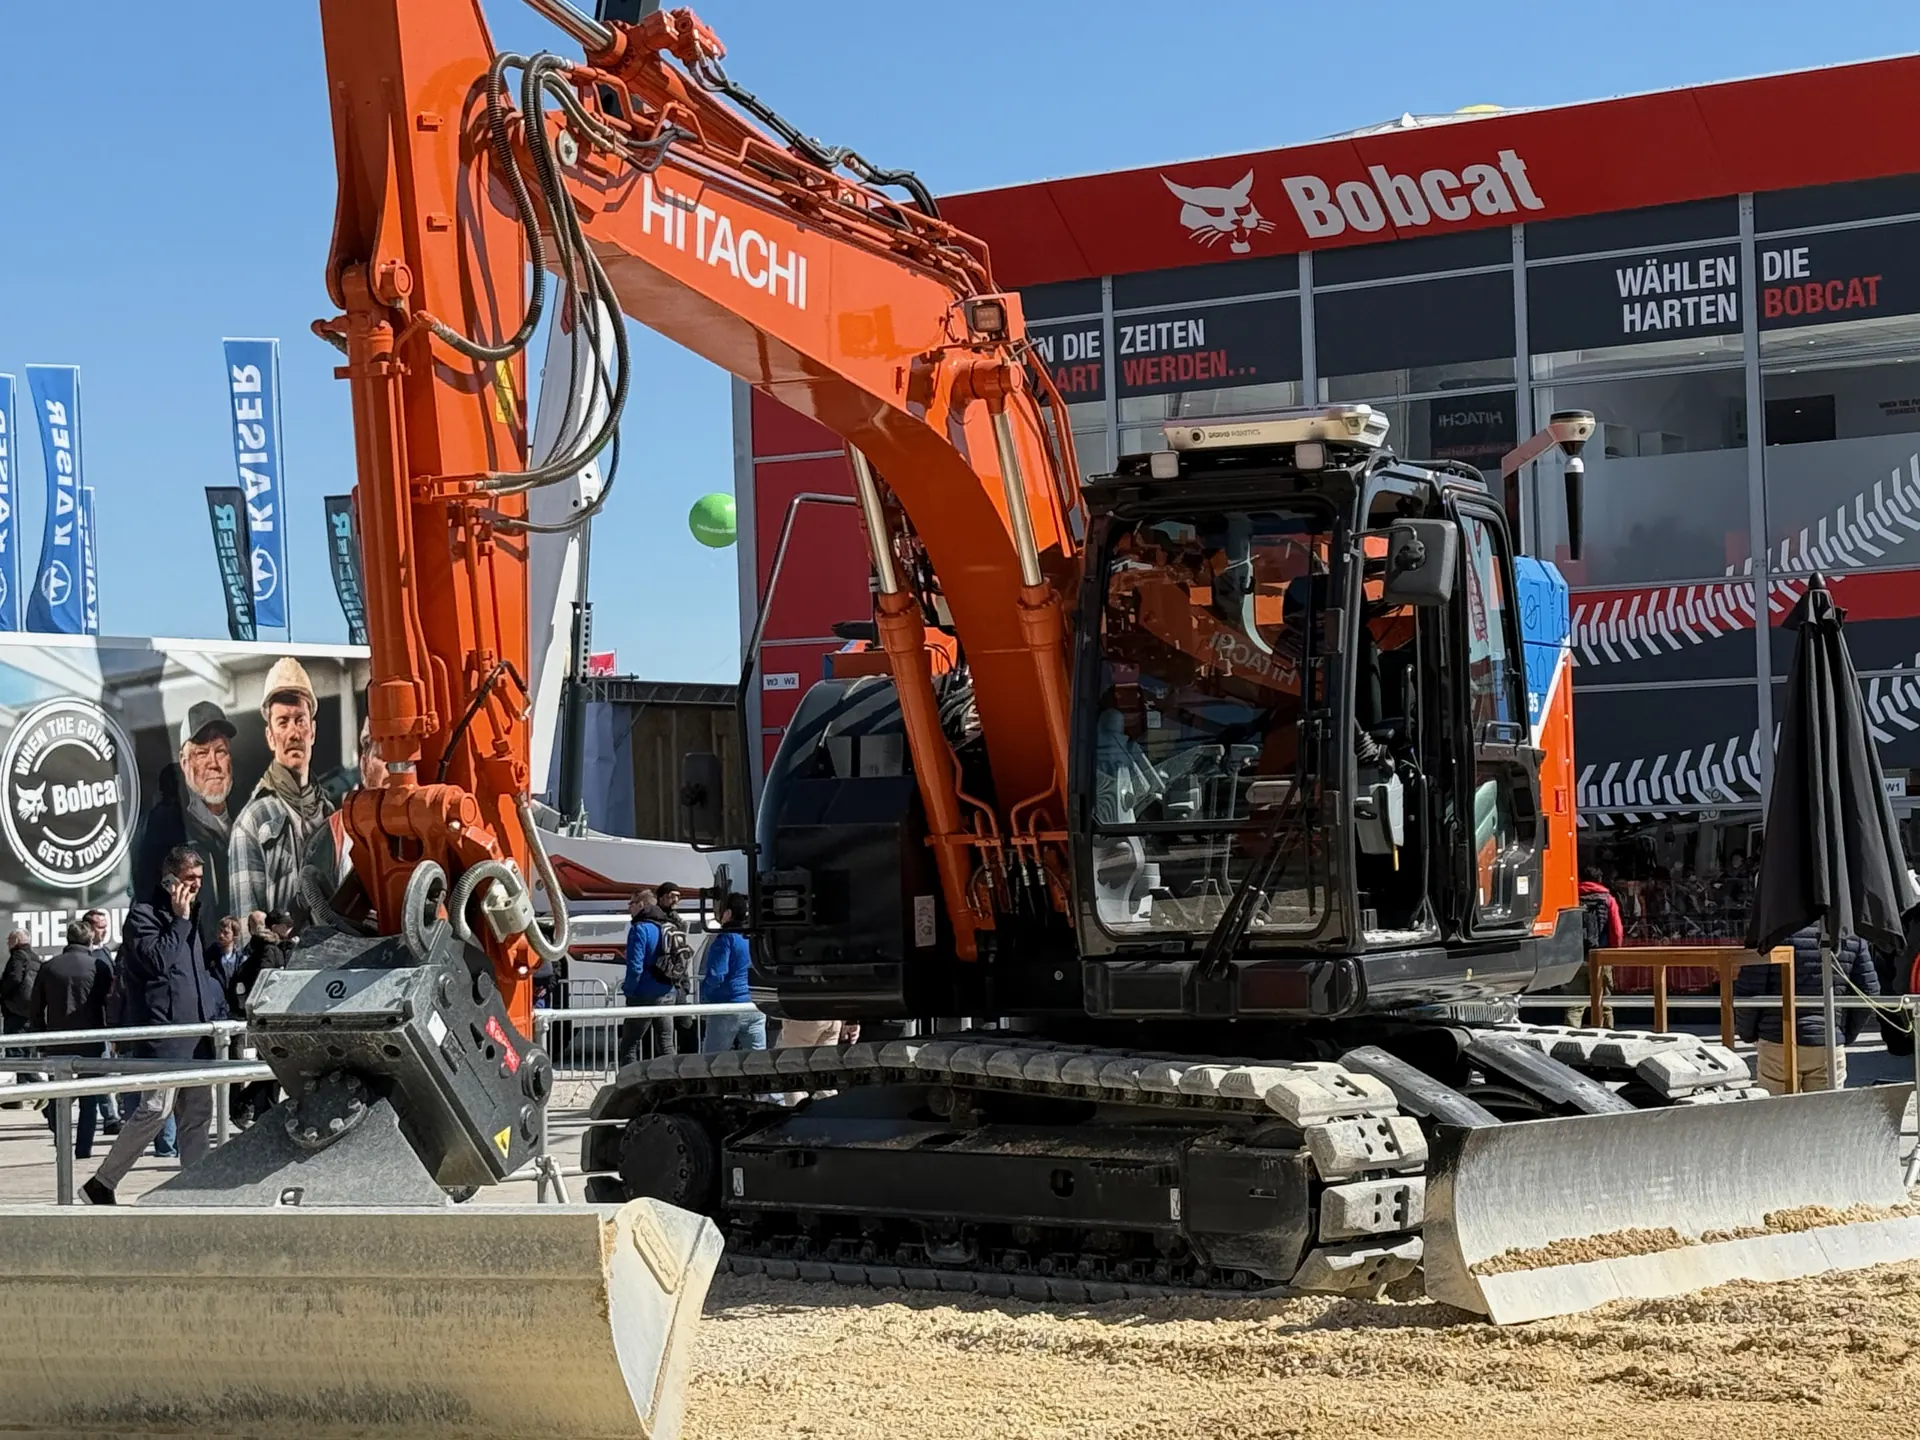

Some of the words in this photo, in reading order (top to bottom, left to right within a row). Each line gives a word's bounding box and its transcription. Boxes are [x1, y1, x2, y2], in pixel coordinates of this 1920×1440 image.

[1281, 149, 1545, 239] Bobcat
[642, 175, 807, 311] HITACHI
[1616, 255, 1736, 297] WÄHLEN
[1762, 247, 1810, 281] DIE
[1623, 292, 1737, 333] HARTEN
[1764, 274, 1882, 318] BOBCAT
[1063, 331, 1100, 361] DIE
[1120, 318, 1205, 354] ZEITEN
[1040, 363, 1100, 395] ART
[15, 727, 49, 776] WHEN
[46, 717, 75, 738] THE
[77, 719, 116, 762] GOING
[52, 773, 125, 816] Bobcat
[1885, 782, 1900, 792] W1
[37, 840, 74, 868] GETS
[75, 825, 118, 868] TOUGH
[12, 910, 68, 948] THE
